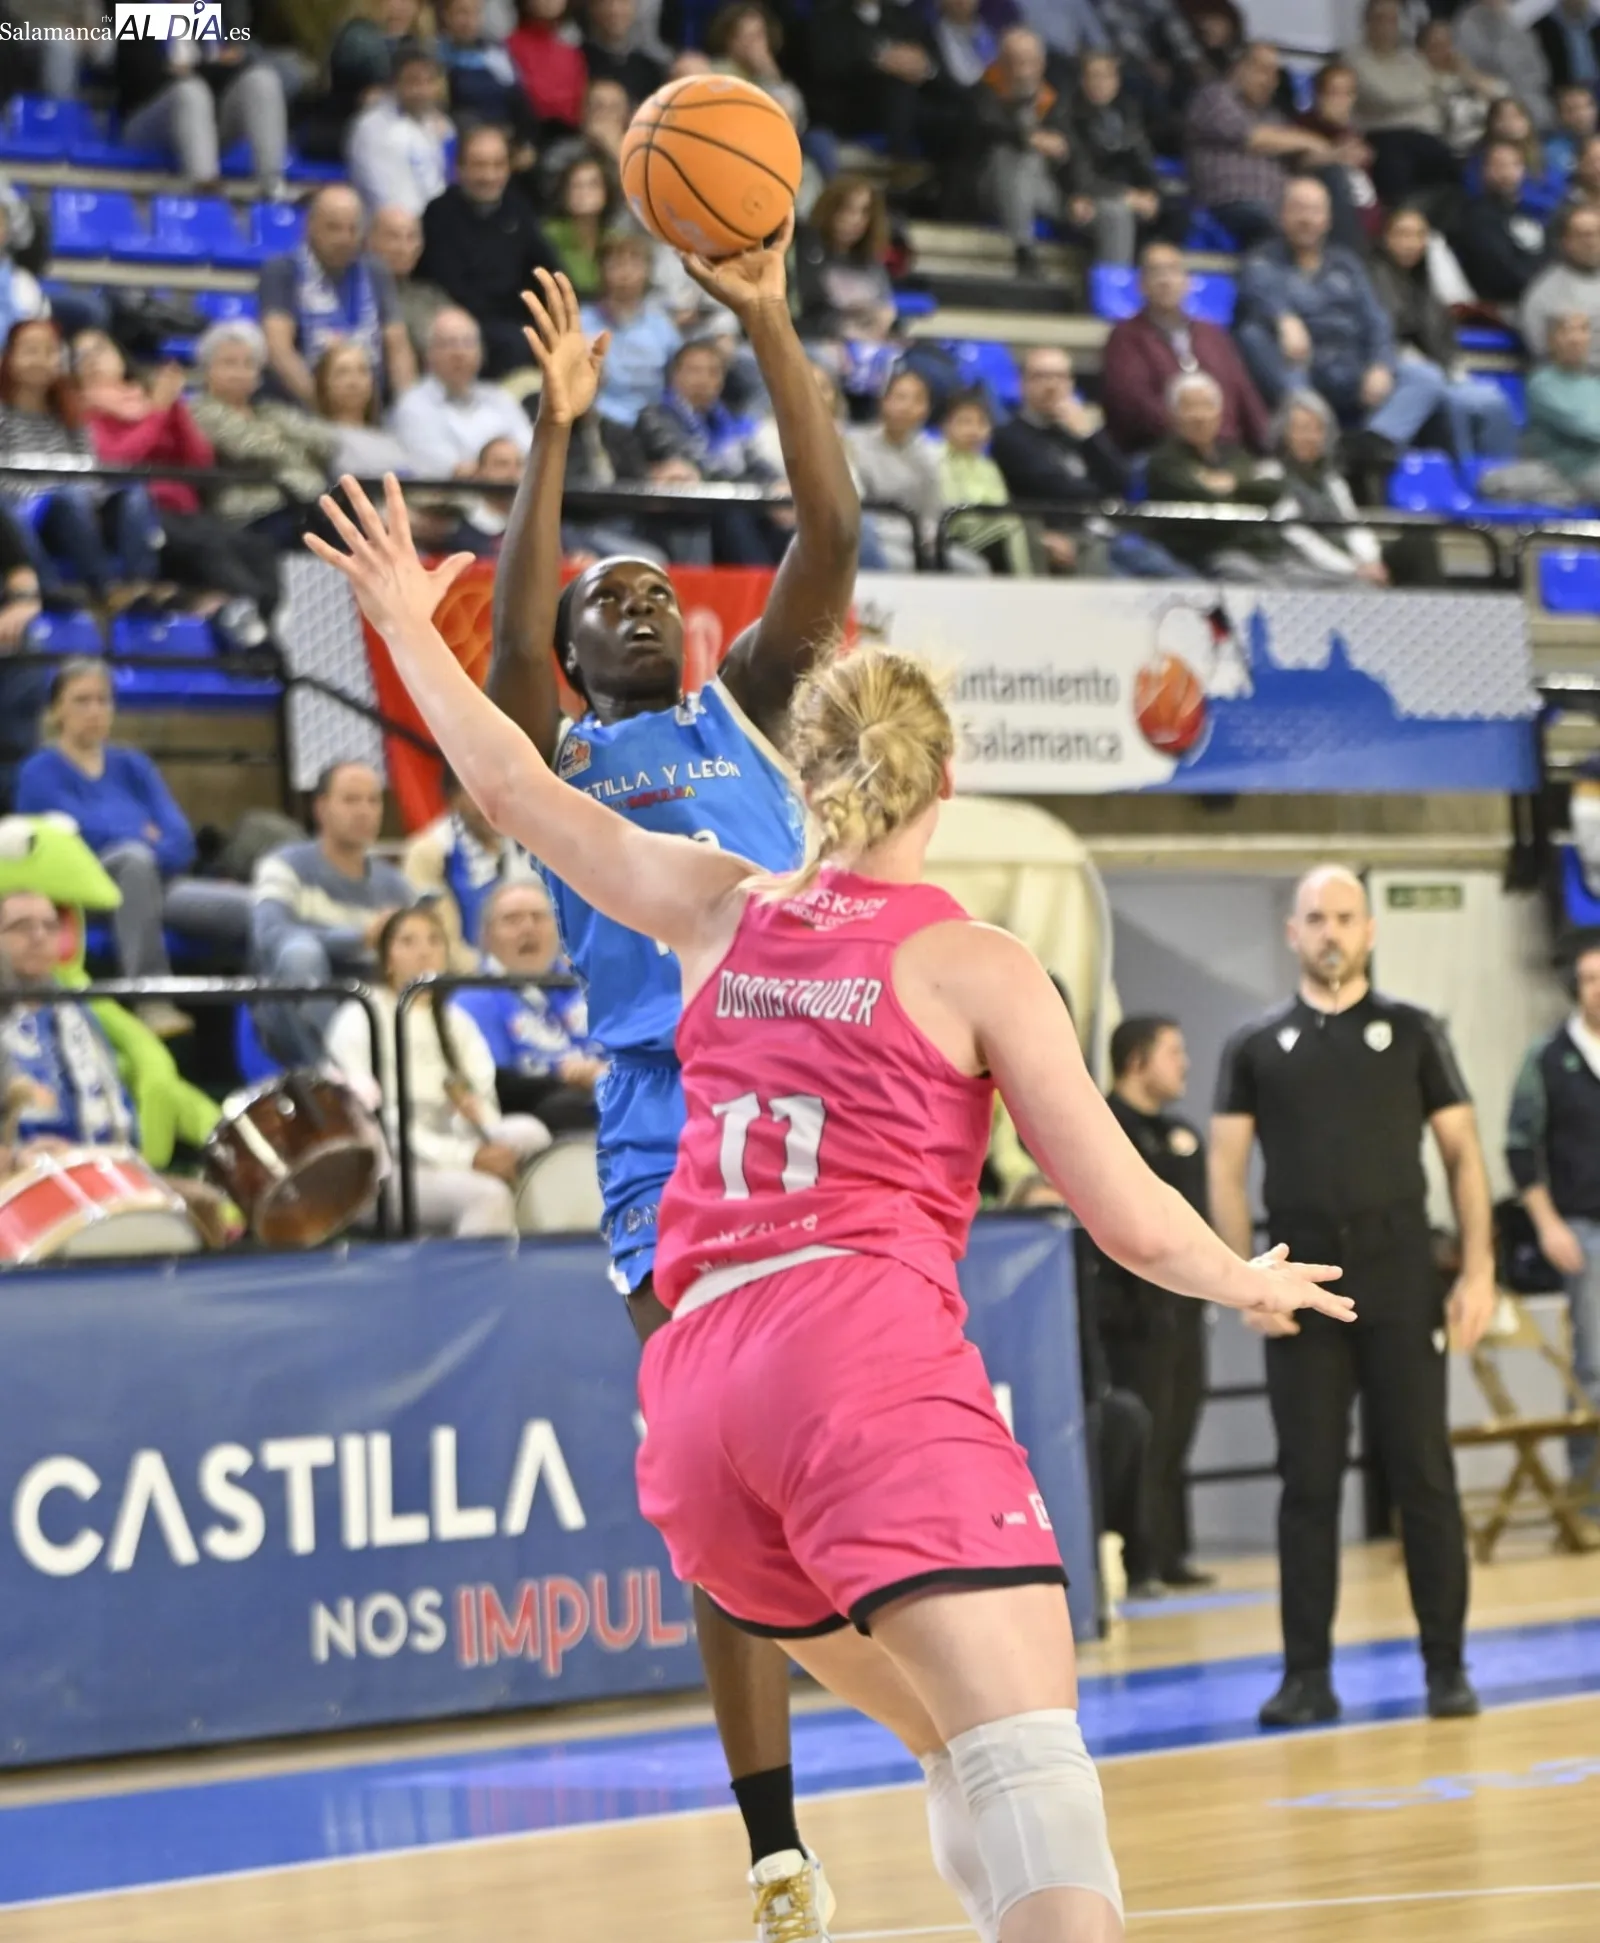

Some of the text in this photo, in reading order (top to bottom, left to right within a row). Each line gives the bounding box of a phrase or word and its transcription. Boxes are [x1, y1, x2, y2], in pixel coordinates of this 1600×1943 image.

[580, 756, 741, 801] STILLA Y LEÓN
[960, 717, 1123, 764] Salamanca
[13, 1418, 587, 1577] CASTILLA
[311, 1567, 692, 1677] NOS IMPUL
